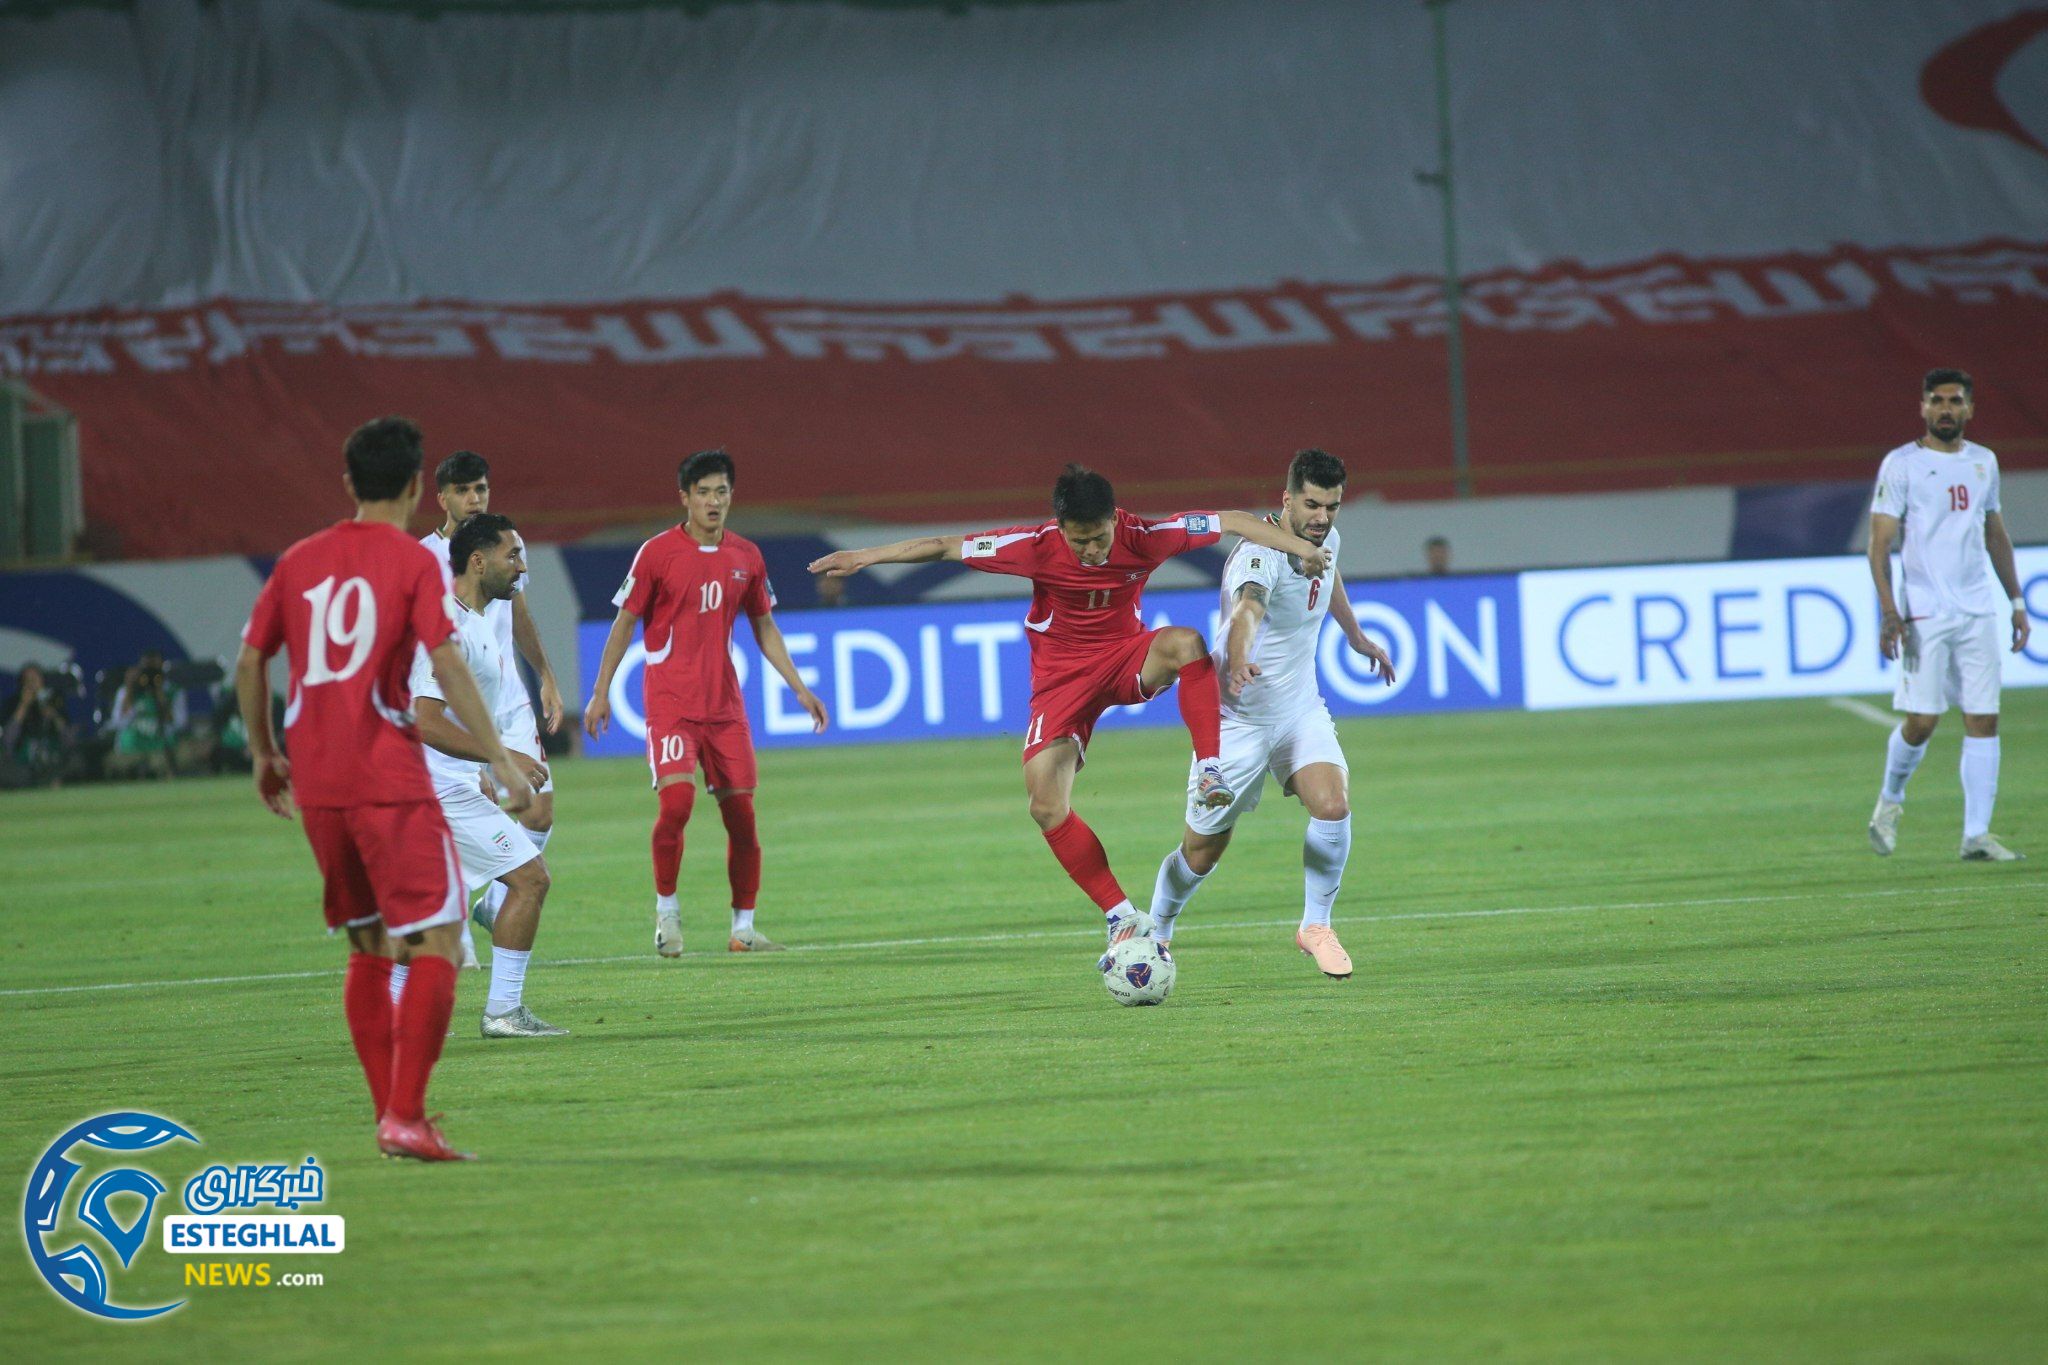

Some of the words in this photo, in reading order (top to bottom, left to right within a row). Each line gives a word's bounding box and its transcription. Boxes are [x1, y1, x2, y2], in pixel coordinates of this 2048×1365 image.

[1947, 484, 1969, 512] 19
[699, 580, 723, 613] 10
[1087, 589, 1112, 610] 11
[1308, 578, 1321, 611] 6
[302, 575, 377, 687] 19
[608, 622, 1022, 742] CEDIT
[660, 735, 684, 764] 10
